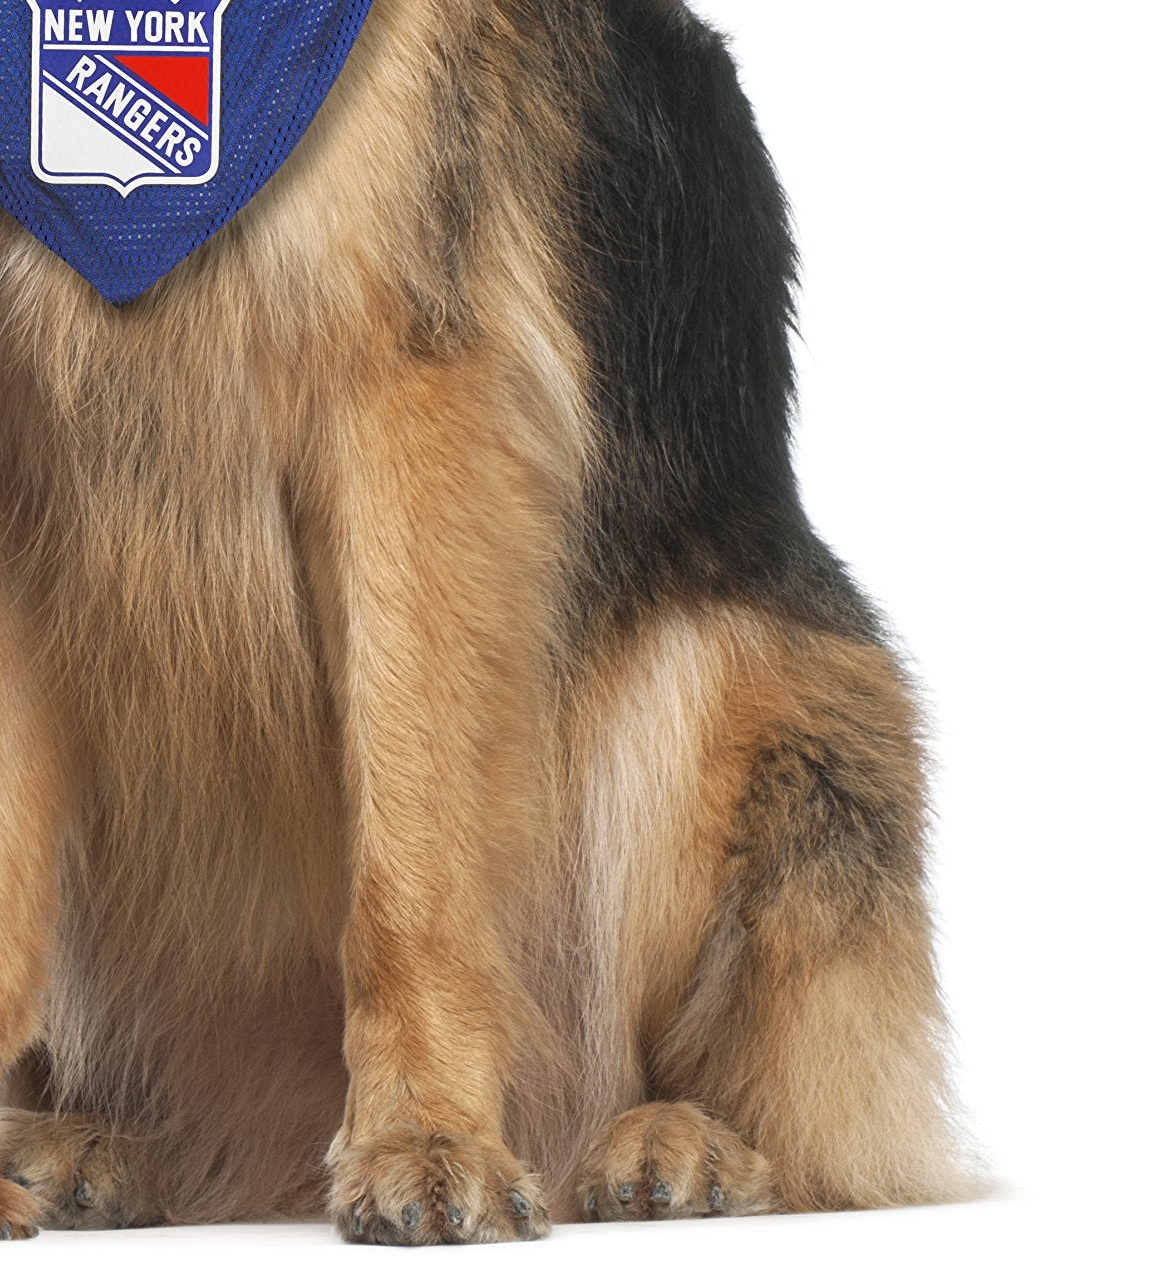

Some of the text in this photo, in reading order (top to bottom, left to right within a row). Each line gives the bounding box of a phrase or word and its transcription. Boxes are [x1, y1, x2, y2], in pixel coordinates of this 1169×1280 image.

[44, 8, 209, 44] NEW YORK
[65, 54, 202, 167] RANGERS
